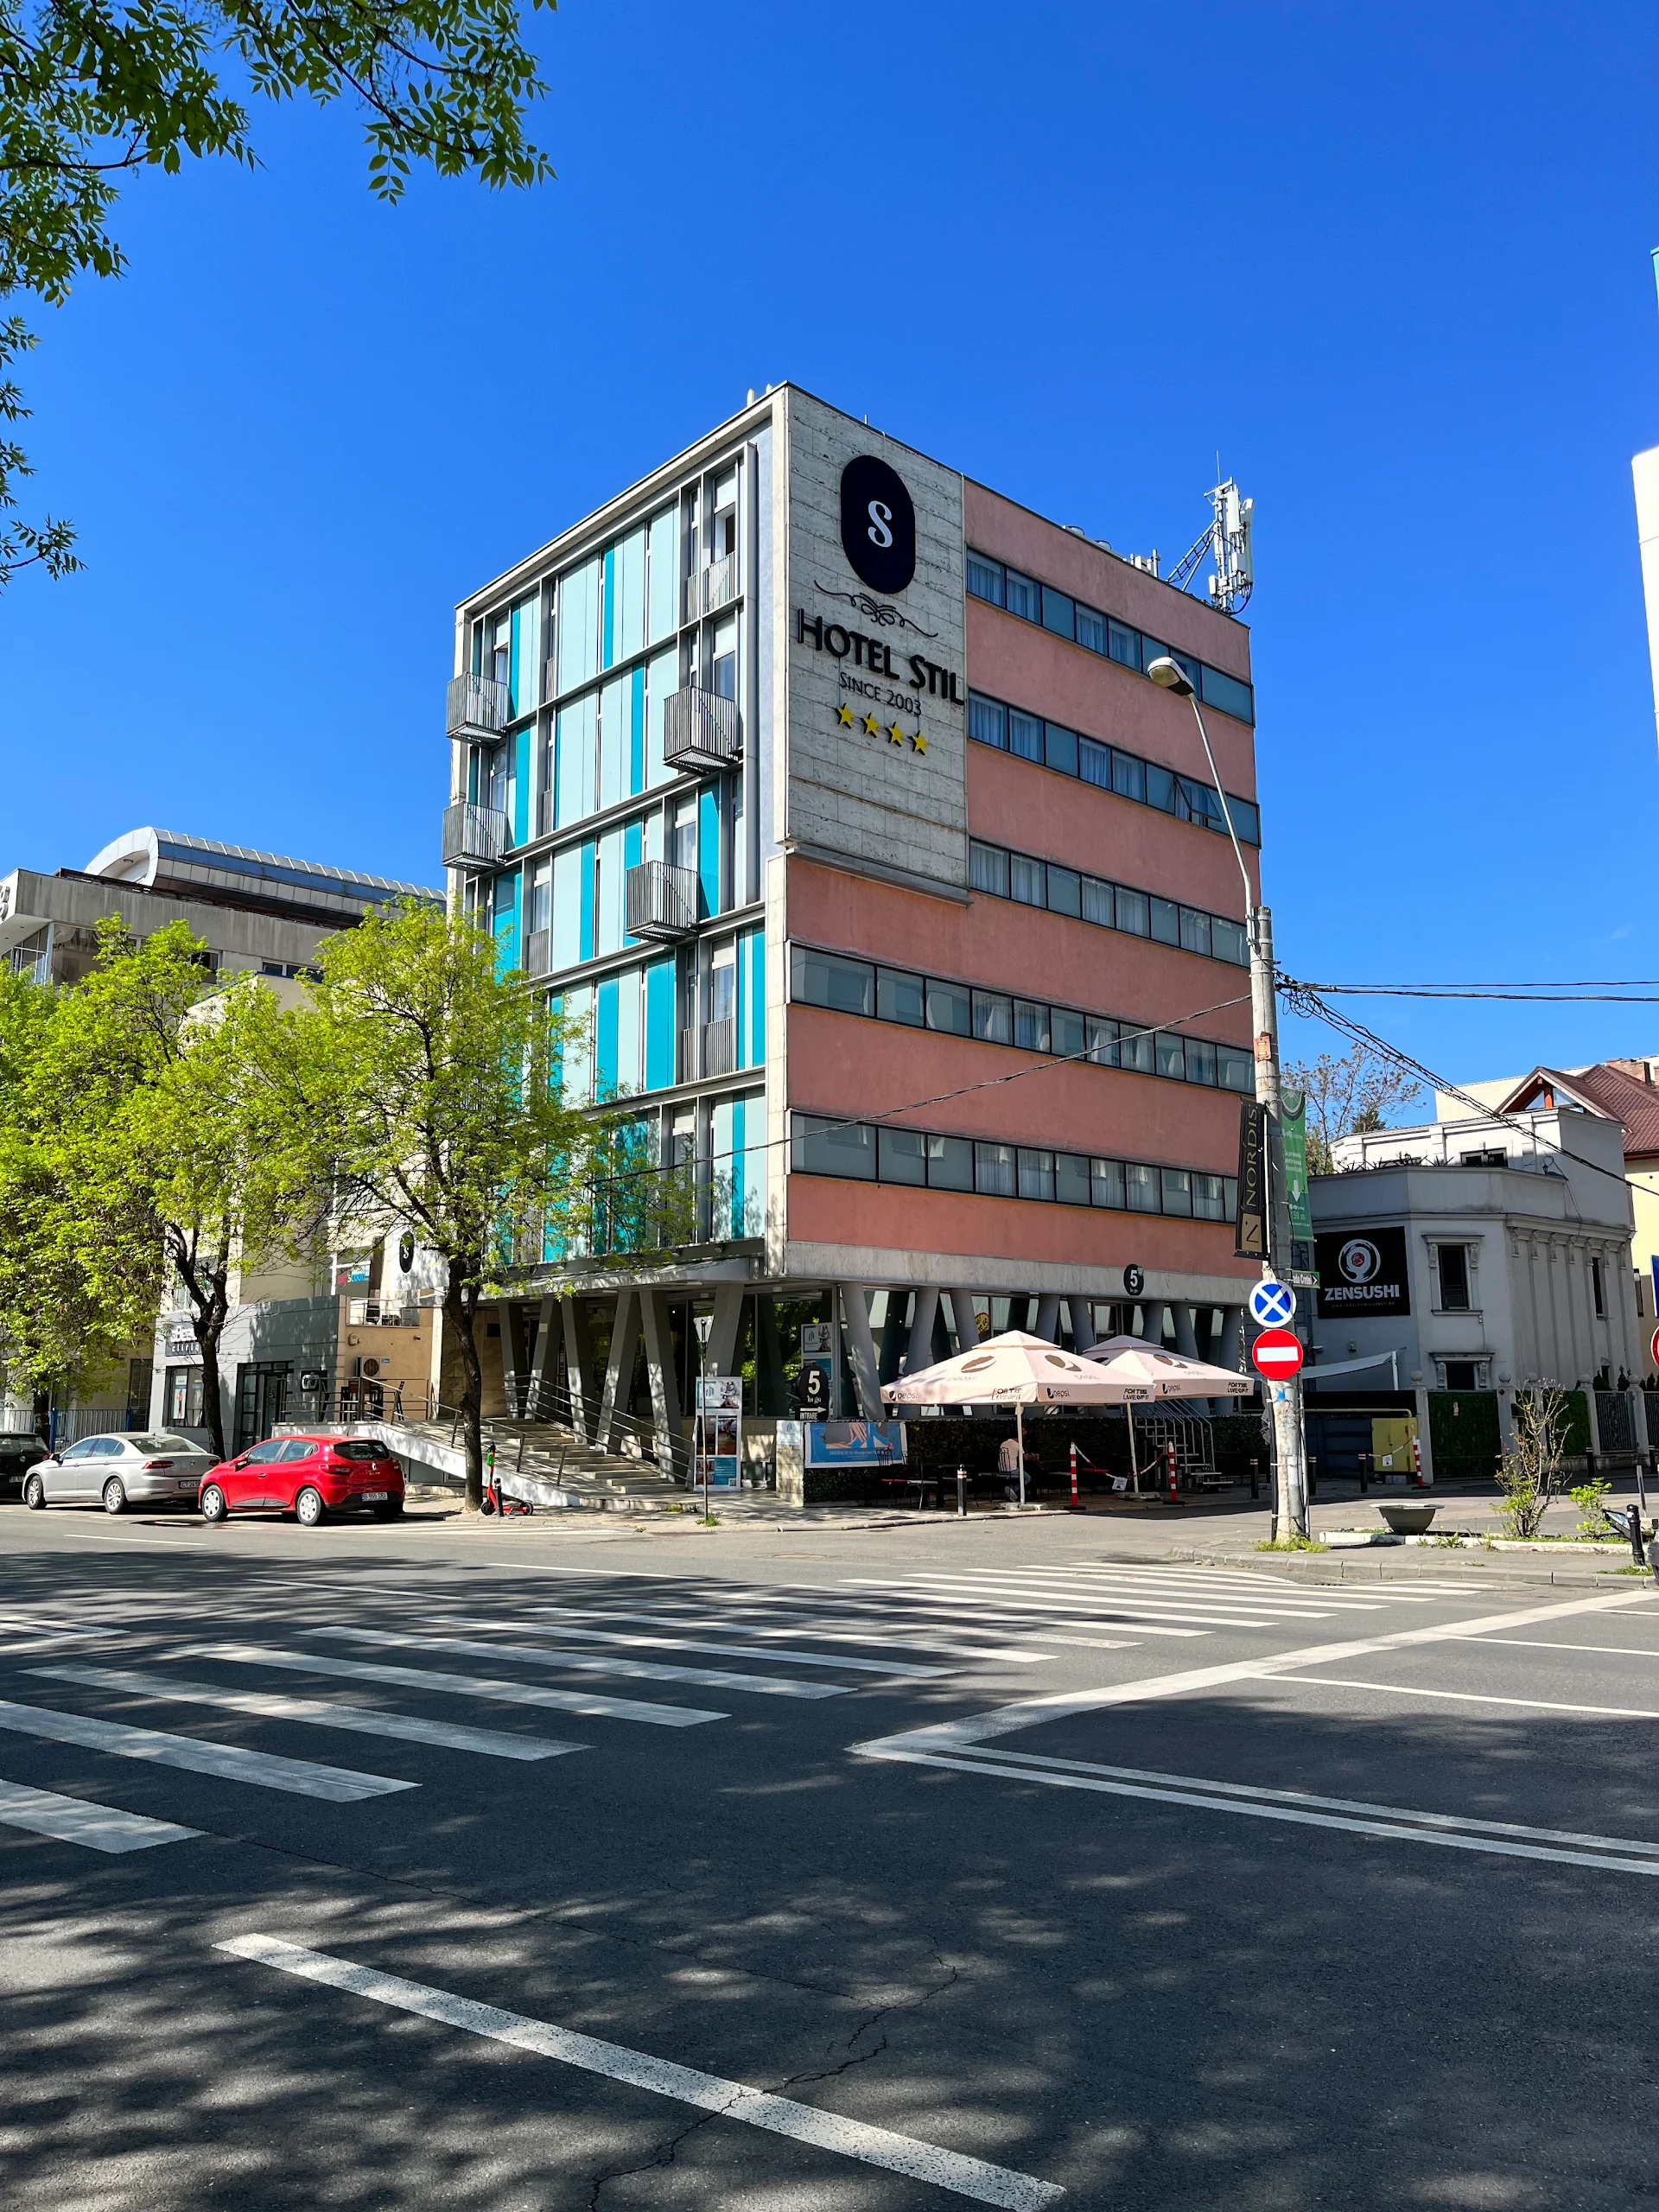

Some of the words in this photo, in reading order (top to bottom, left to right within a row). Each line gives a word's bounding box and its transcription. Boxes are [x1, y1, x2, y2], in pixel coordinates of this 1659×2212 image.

[868, 500, 893, 548] S
[798, 608, 900, 680] HOTEL
[909, 654, 965, 706] STIL
[840, 671, 881, 702] SINCE
[887, 690, 922, 716] 2003
[1246, 1108, 1257, 1207] NORDIS
[1129, 1269, 1138, 1287] 5
[1324, 1284, 1400, 1301] ZENSUSHI
[808, 1370, 821, 1395] 5
